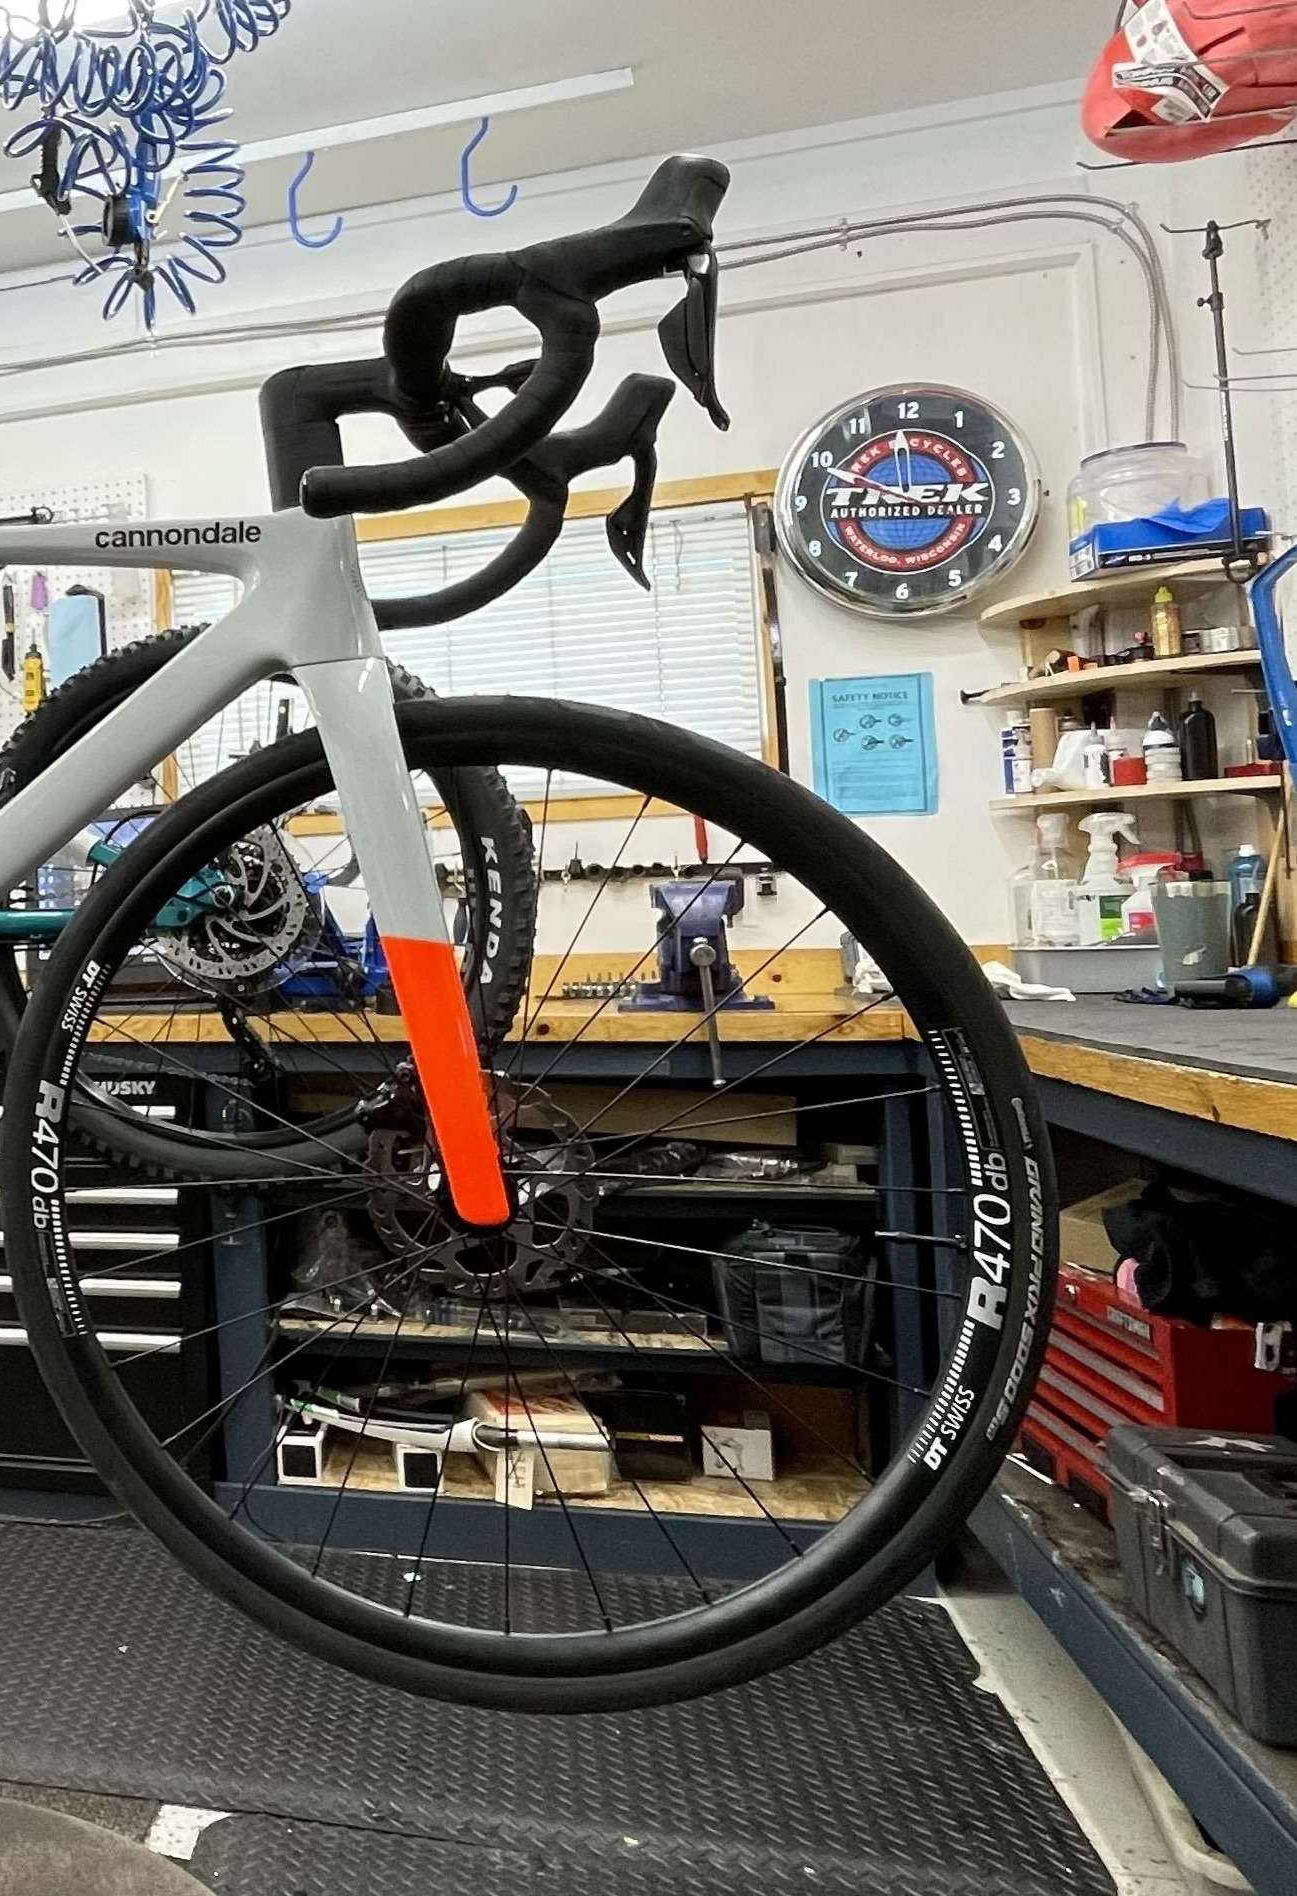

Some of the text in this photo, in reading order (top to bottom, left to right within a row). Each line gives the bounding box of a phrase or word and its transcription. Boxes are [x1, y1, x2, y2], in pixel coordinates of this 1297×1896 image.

[897, 402, 919, 419] 12
[849, 418, 866, 434] 11
[954, 411, 964, 428] 1
[888, 438, 968, 477] BCYCLES
[991, 441, 1005, 458] 2
[811, 451, 833, 468] 10
[826, 483, 990, 506] TREK
[1007, 488, 1021, 505] 3
[795, 496, 808, 512] 9
[830, 503, 983, 519] AUTHORIZED DEALER
[95, 520, 262, 548] cannondale
[808, 540, 822, 557] 8
[987, 534, 1003, 552] 4
[845, 572, 858, 588] 7
[948, 570, 962, 587] 5
[895, 583, 909, 599] 6
[832, 691, 908, 702] SAFETY NOTICE
[480, 836, 503, 984] KENDA
[61, 960, 101, 1033] DT SWISS
[93, 1081, 156, 1095] HUSKY
[30, 1079, 66, 1230] R470 db
[1023, 1156, 1044, 1256] GRAND
[966, 1152, 1011, 1330] R470 db
[1024, 1253, 1043, 1326] PRIX
[923, 1385, 975, 1471] DT SWISS
